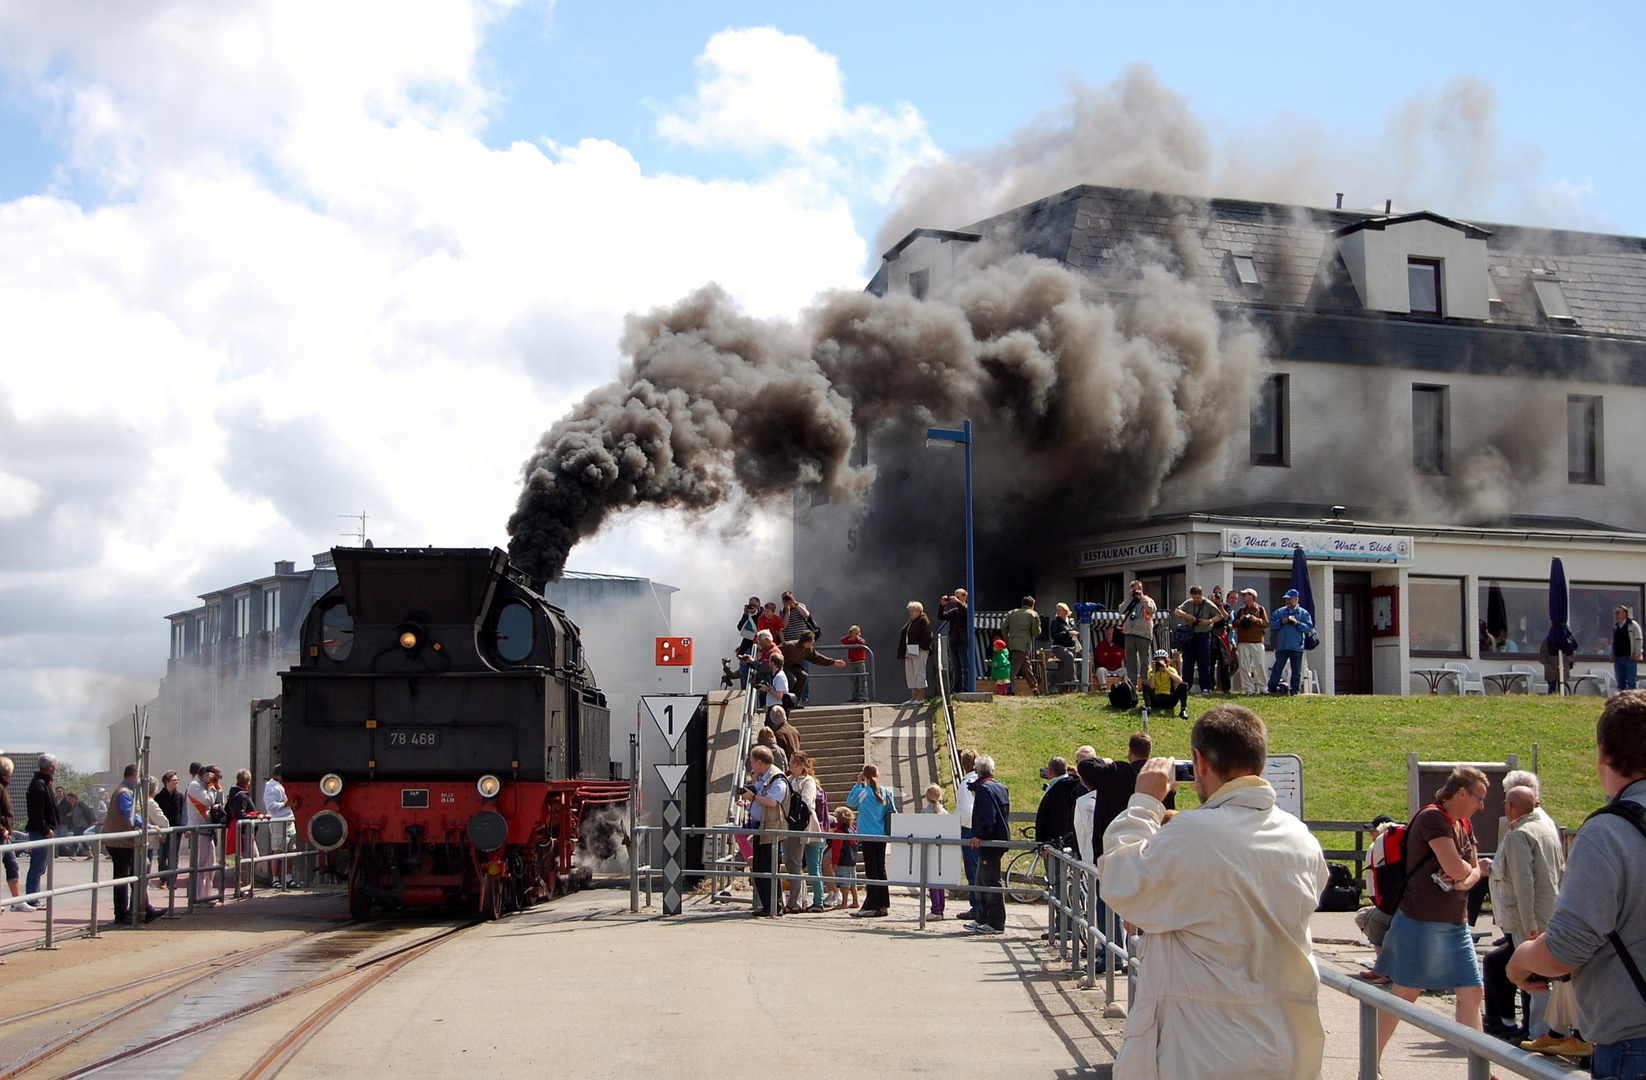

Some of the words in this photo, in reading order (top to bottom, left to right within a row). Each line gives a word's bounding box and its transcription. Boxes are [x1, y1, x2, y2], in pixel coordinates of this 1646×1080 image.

[1245, 536, 1276, 547] Watt'n
[1334, 540, 1365, 551] Watt'n
[1369, 541, 1393, 553] Blick
[664, 704, 674, 735] 1
[391, 733, 406, 745] 78
[411, 733, 436, 745] 468
